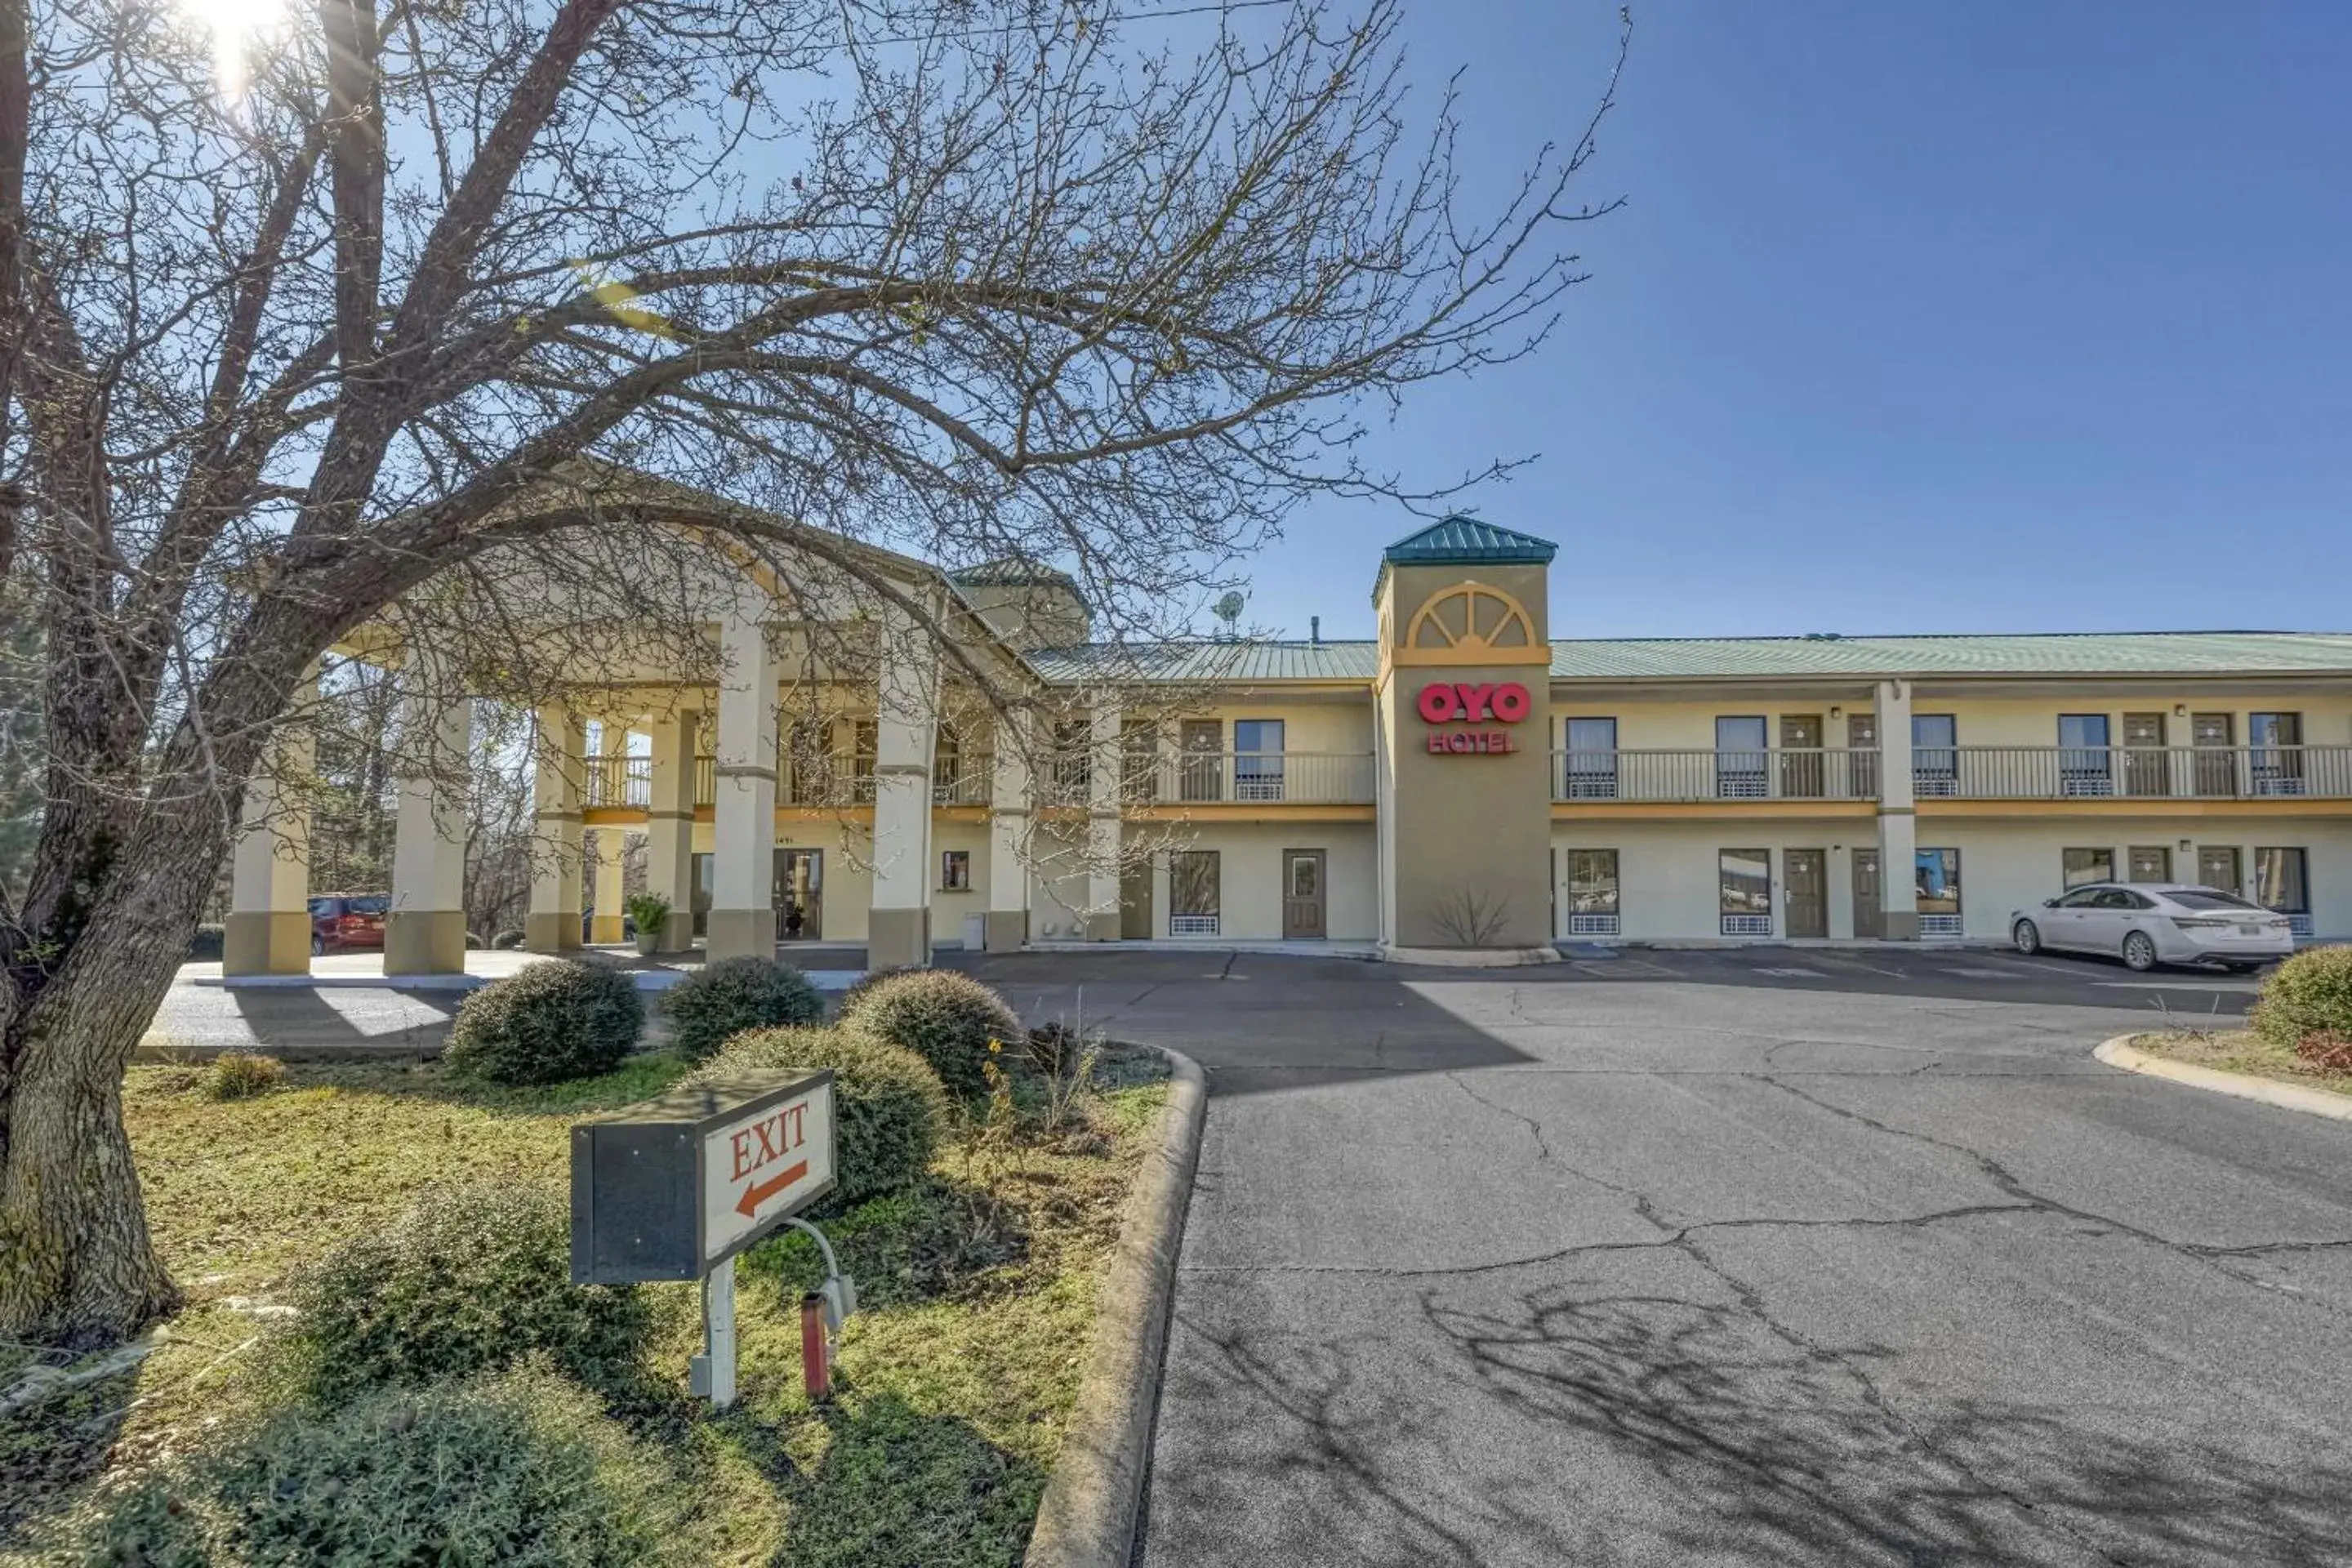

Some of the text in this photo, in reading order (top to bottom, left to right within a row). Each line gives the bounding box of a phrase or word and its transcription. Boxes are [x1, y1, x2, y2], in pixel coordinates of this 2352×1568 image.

[1419, 683, 1530, 723] OYO
[1428, 732, 1515, 753] HOTEL
[730, 1099, 808, 1182] EXIT
